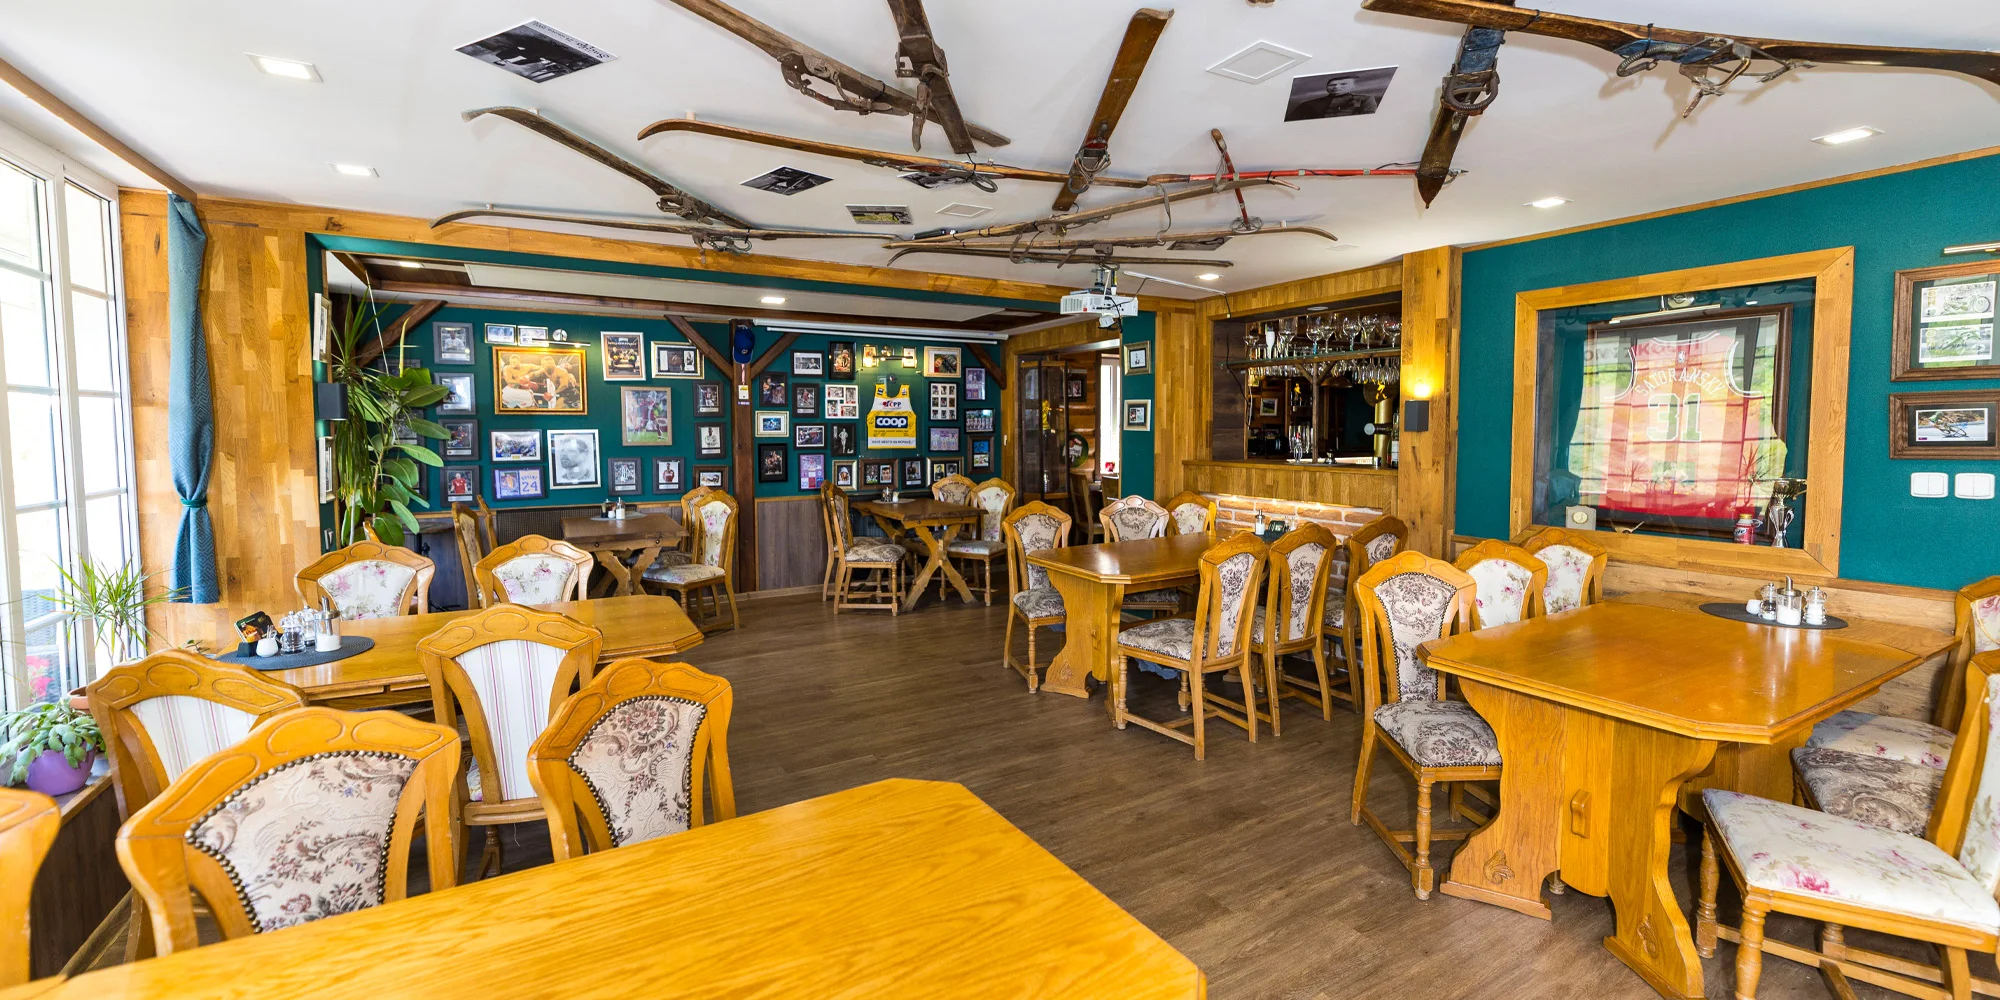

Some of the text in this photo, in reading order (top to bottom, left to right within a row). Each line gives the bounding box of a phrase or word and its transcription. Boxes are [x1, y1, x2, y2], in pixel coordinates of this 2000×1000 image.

[1635, 367, 1726, 396] SATORANSKY
[876, 418, 906, 427] coop
[1647, 393, 1702, 443] 31
[522, 481, 538, 492] 24
